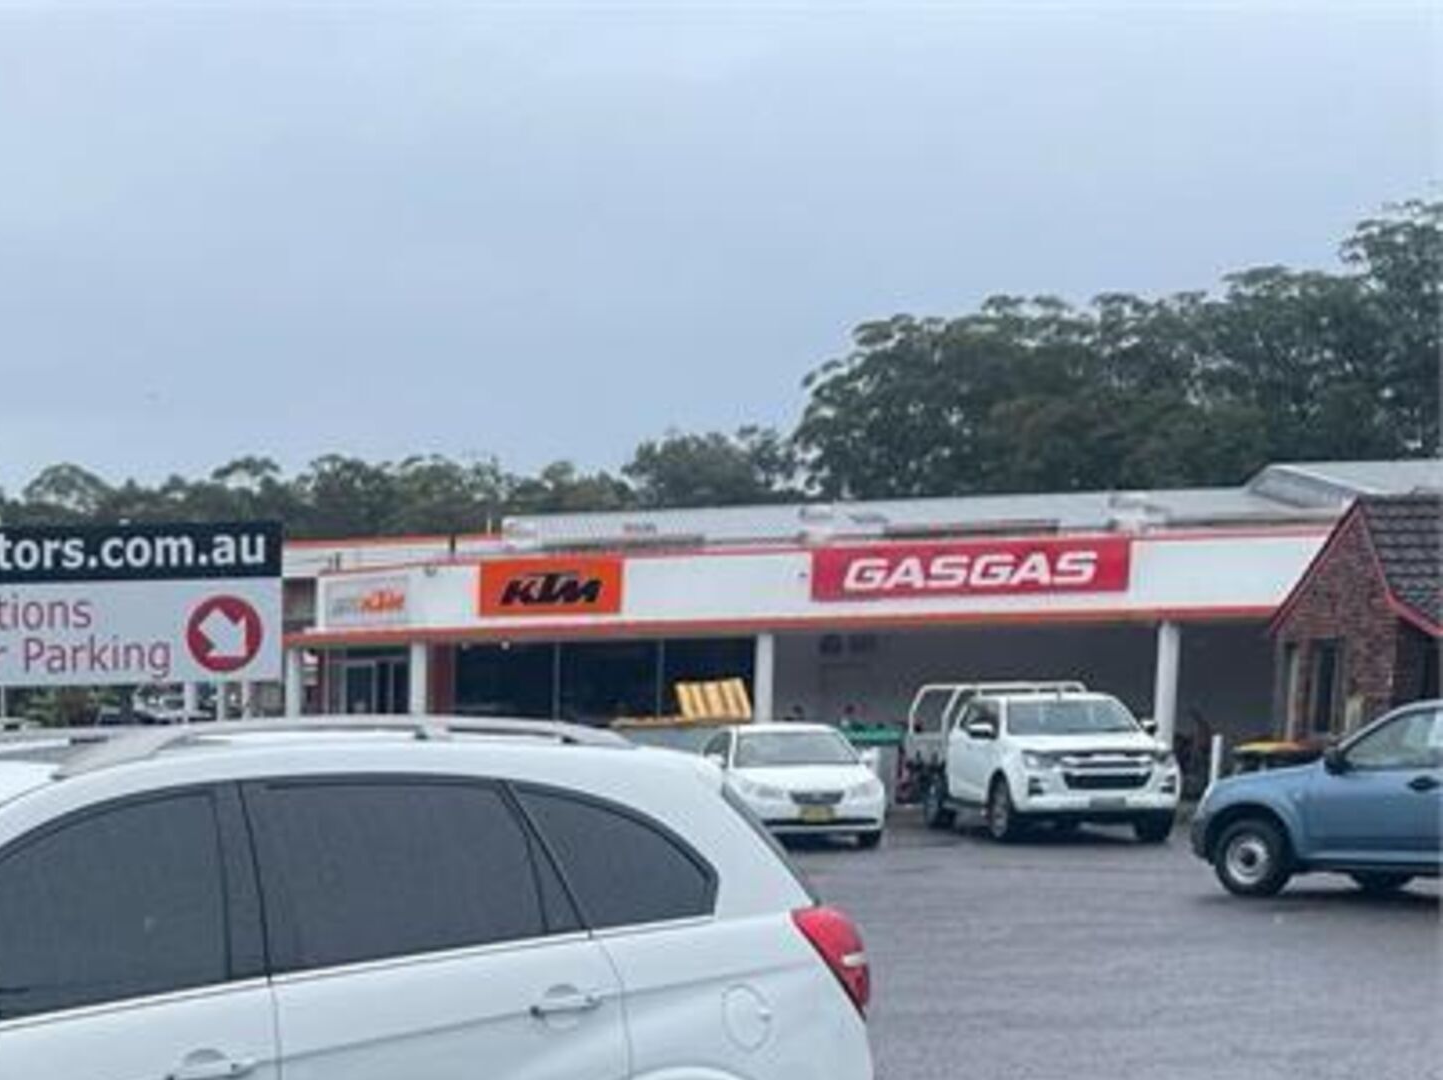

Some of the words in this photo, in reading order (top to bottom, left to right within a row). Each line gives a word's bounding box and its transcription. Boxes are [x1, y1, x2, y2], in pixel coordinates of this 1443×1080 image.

[500, 572, 603, 606] KTM
[843, 551, 1098, 590] GASGAS
[22, 635, 173, 677] Parking
